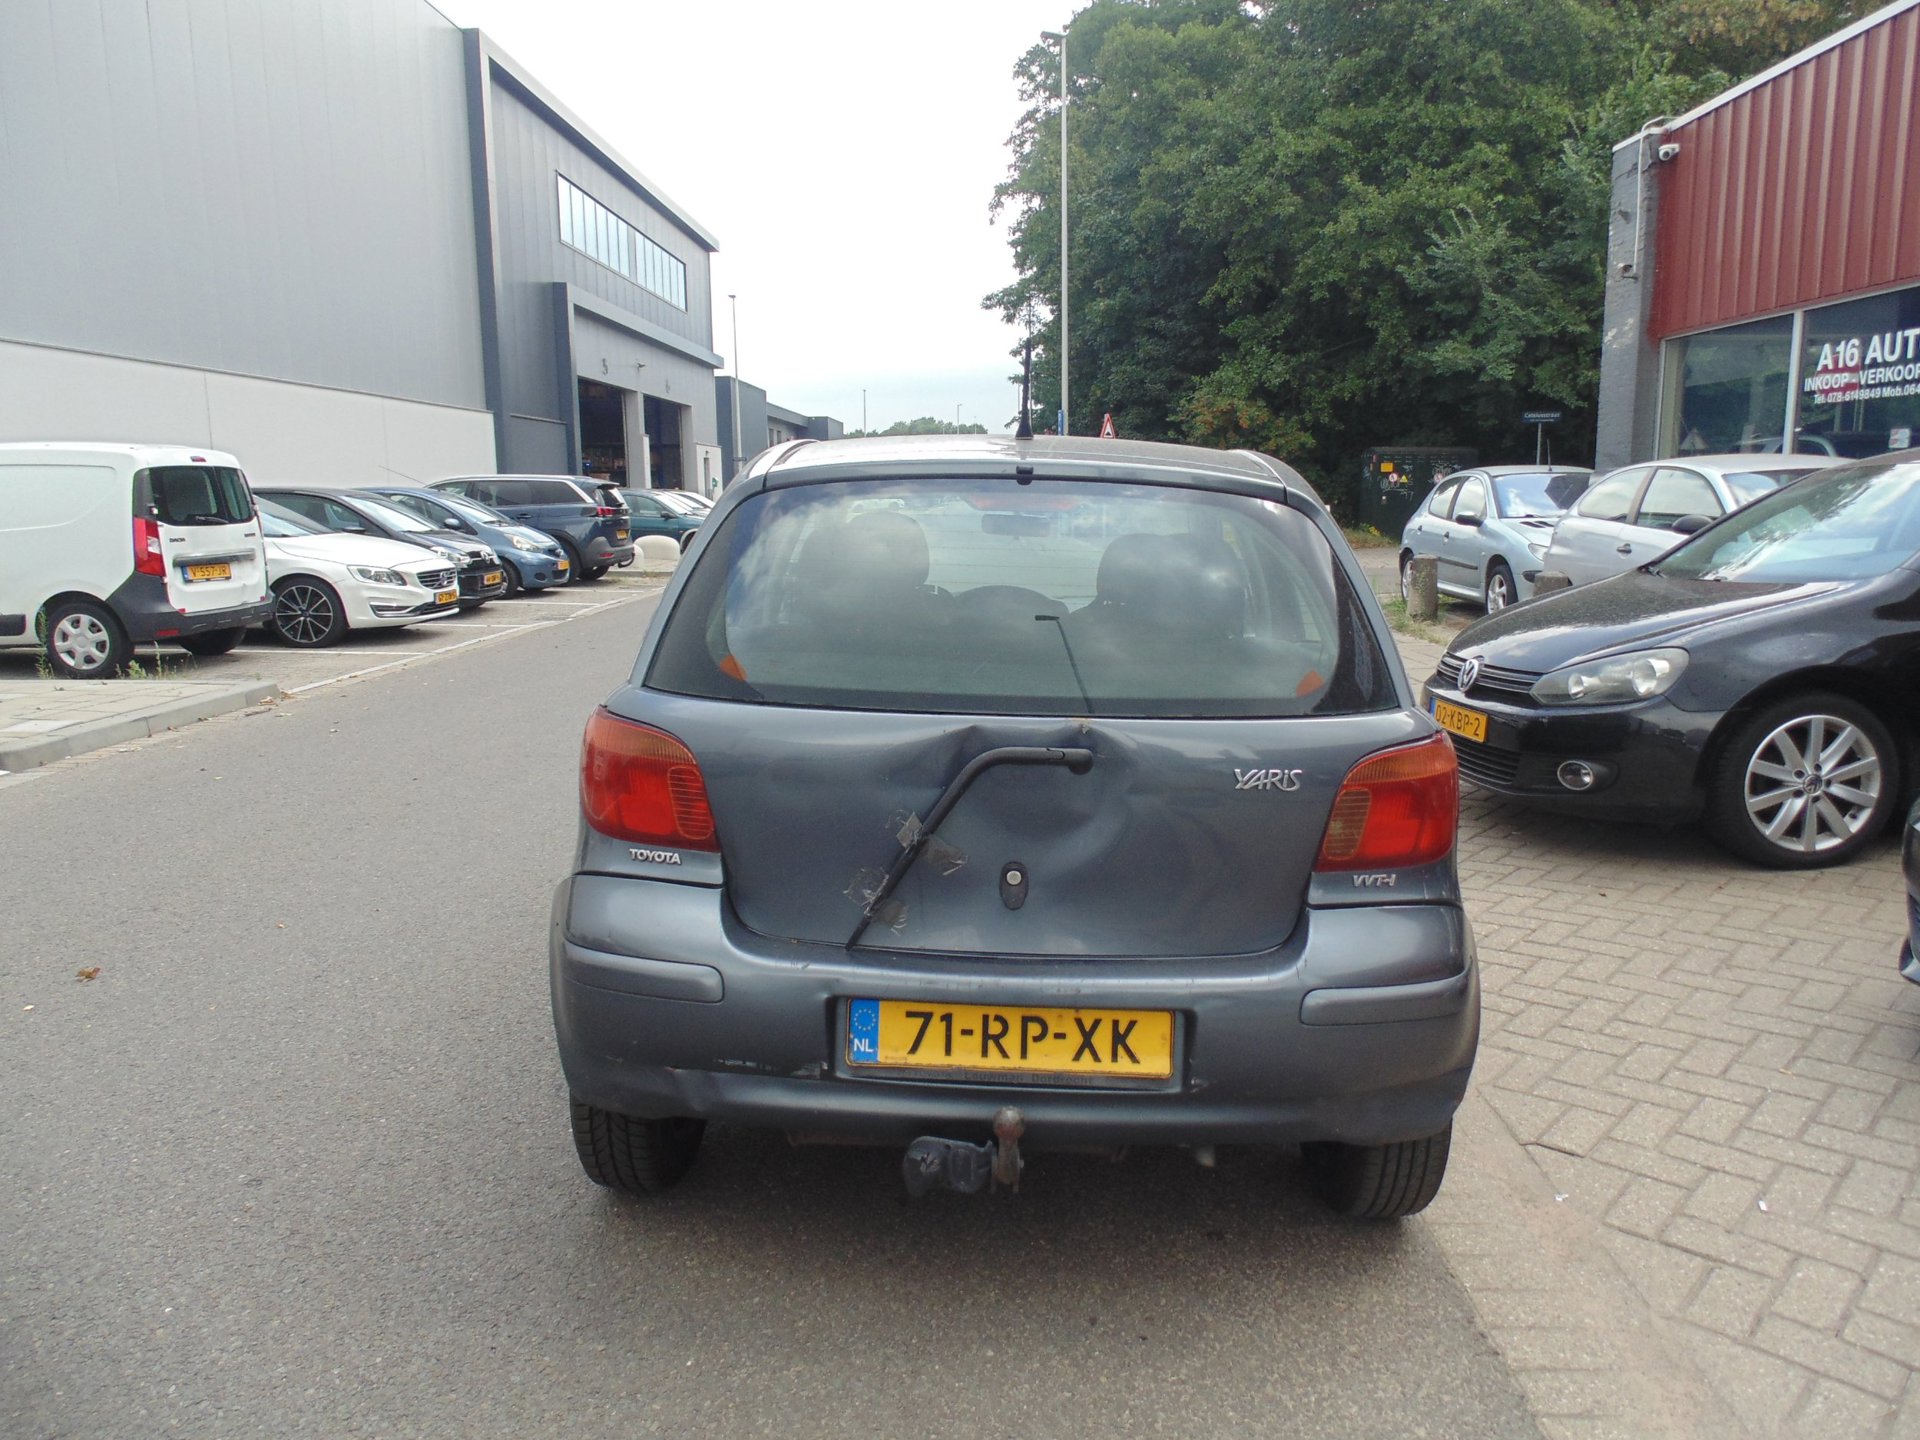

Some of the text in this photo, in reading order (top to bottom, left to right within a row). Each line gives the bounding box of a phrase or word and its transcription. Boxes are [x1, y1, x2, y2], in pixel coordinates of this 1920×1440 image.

[1817, 338, 1860, 371] A16
[1804, 373, 1849, 392] INKOOP
[190, 565, 228, 577] V-557-JR
[1435, 704, 1480, 737] 02-KBP-2
[629, 848, 682, 865] TOYOTA
[853, 1038, 874, 1053] NL
[905, 1010, 1141, 1064] 71-RP-XK
